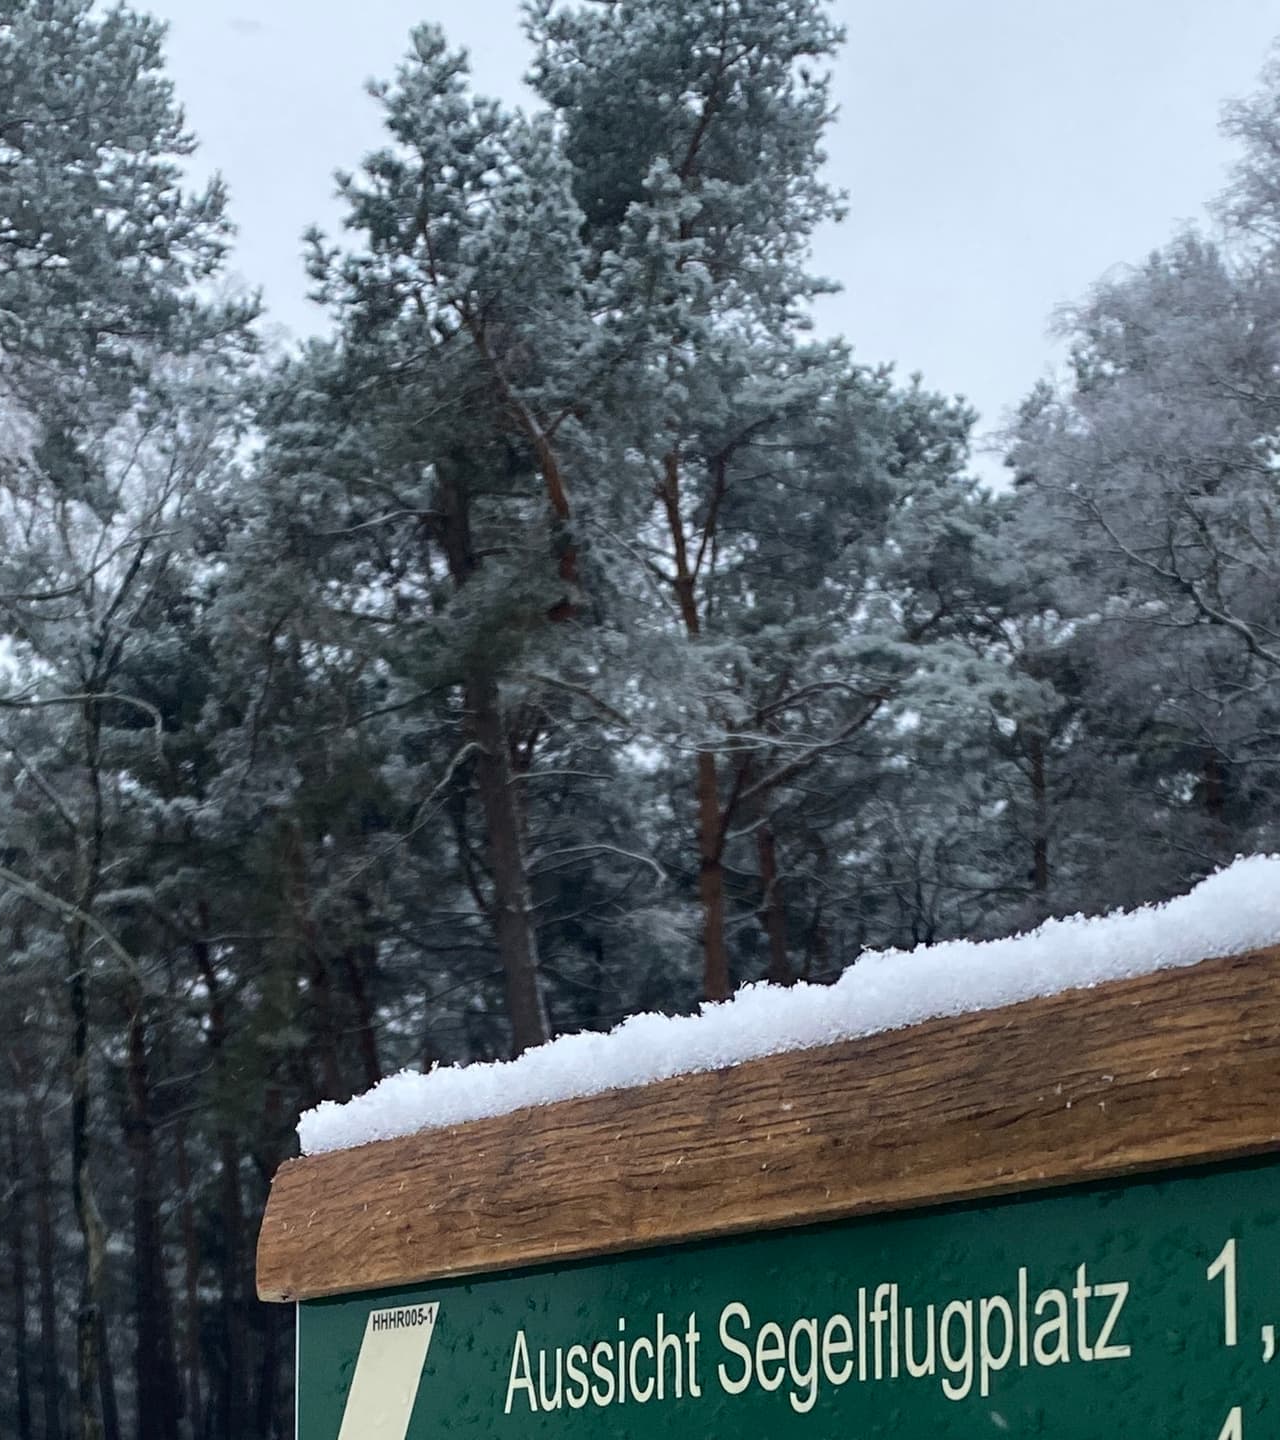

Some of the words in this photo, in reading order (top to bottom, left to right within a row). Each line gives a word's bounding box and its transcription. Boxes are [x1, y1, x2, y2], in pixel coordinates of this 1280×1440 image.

[372, 1306, 433, 1331] HHHR005-1
[504, 1311, 701, 1413] Aussicht
[718, 1262, 1131, 1413] Segelflugplatz
